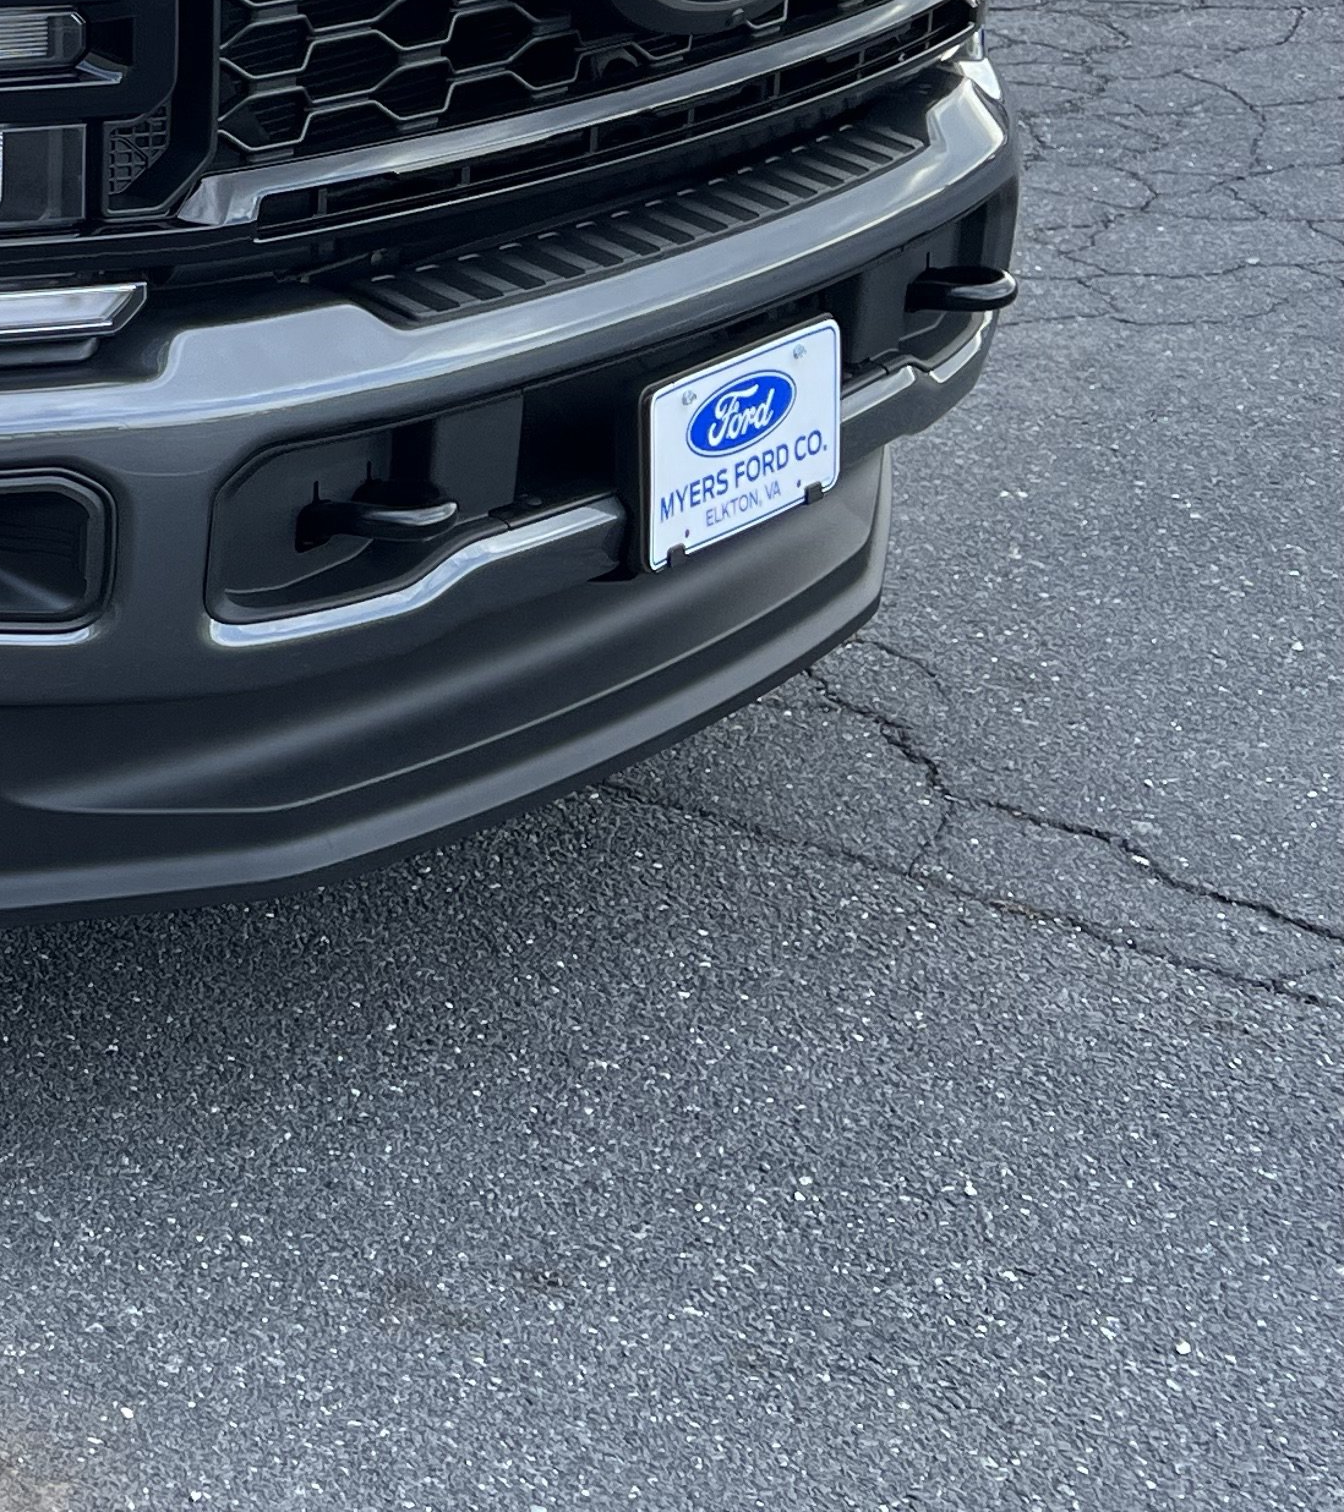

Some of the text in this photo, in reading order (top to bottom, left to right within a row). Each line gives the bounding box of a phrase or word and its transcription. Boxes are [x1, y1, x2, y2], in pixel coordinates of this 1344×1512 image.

[708, 384, 775, 447] Ford
[660, 429, 827, 523] MYERS FORD CO.
[764, 480, 781, 501] VA
